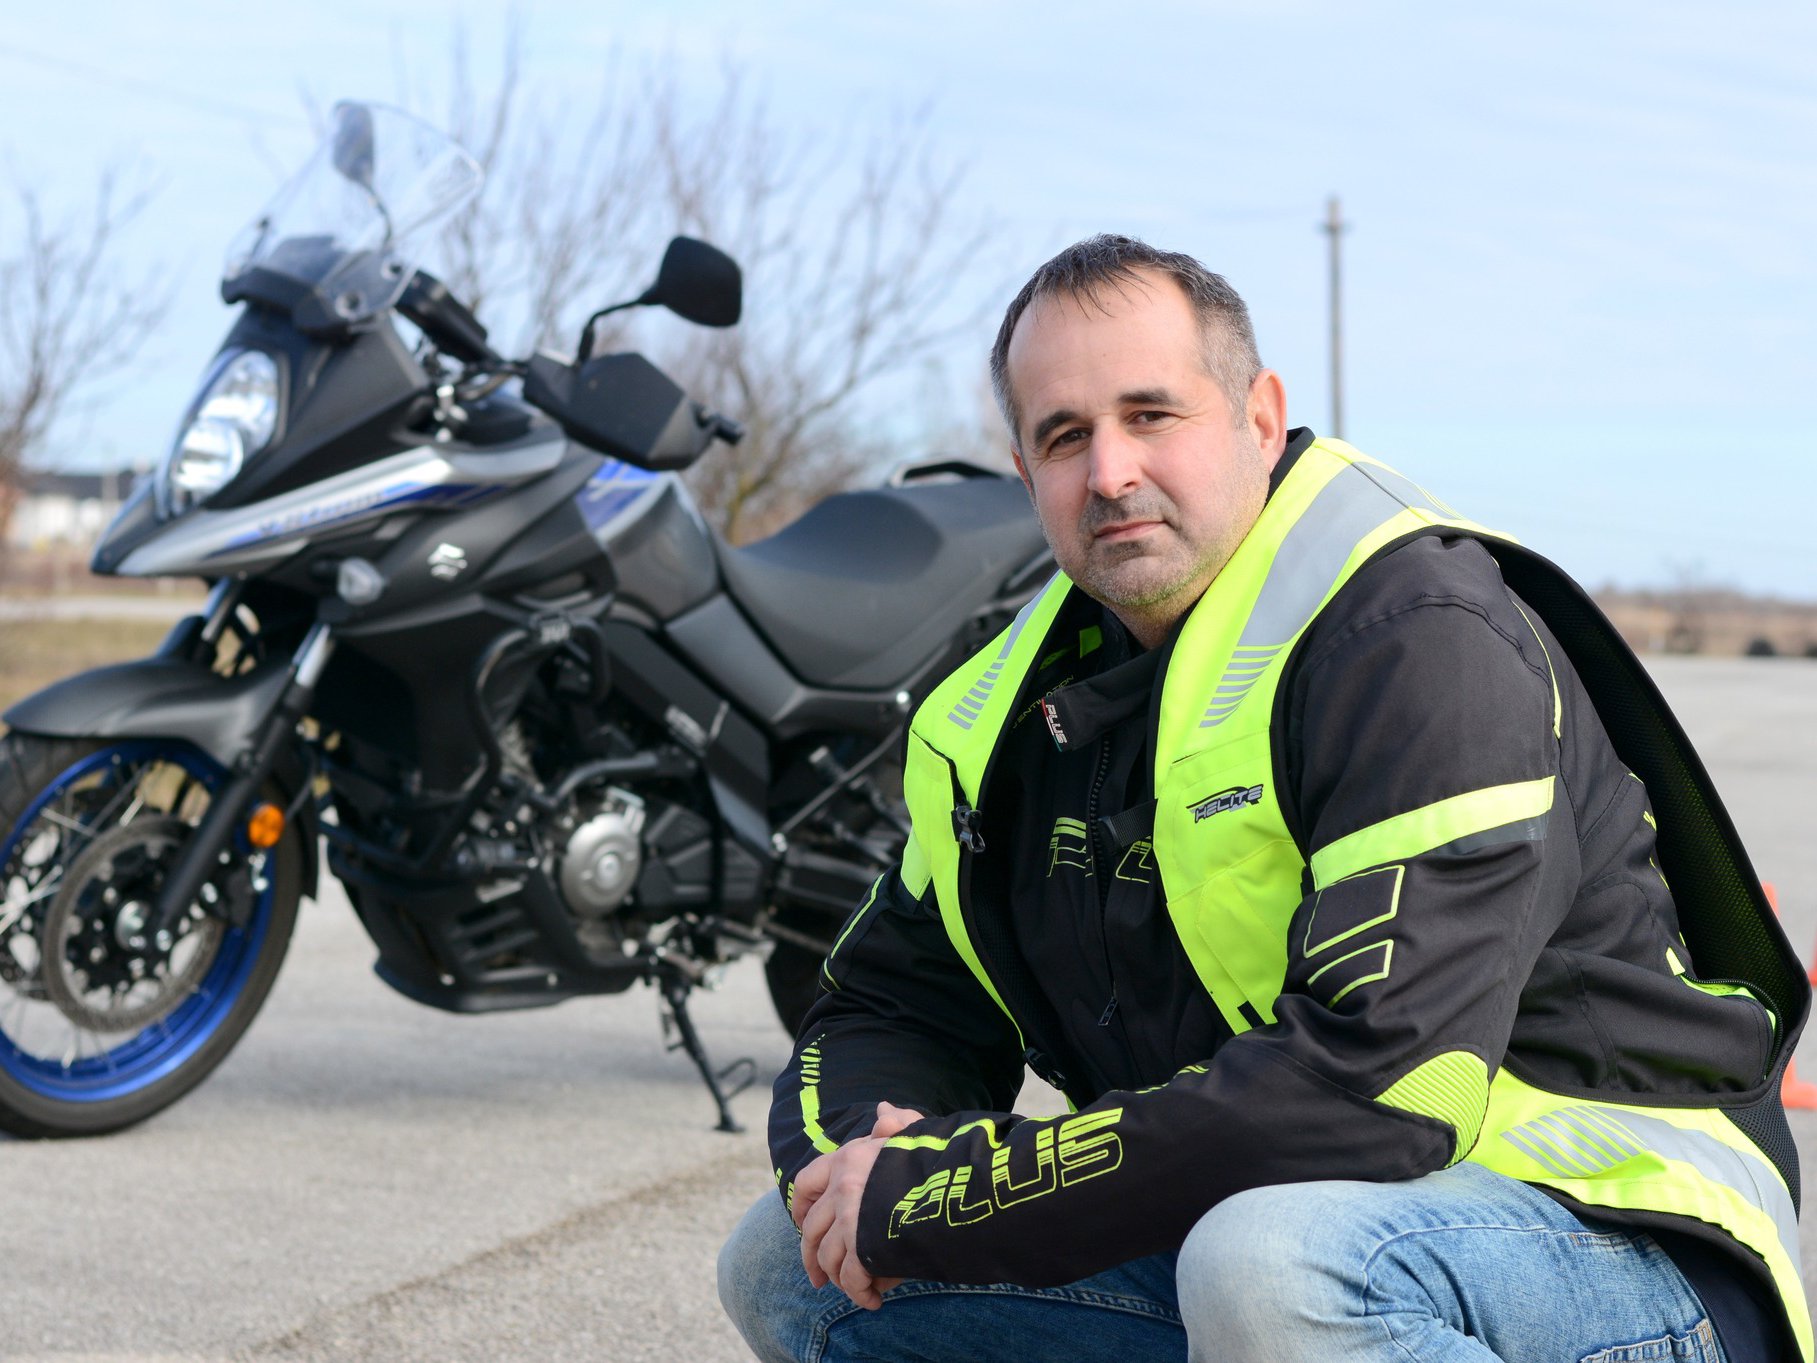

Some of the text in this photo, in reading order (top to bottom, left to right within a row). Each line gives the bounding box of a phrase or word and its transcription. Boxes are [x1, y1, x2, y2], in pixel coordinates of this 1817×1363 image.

[1045, 704, 1068, 744] PLUS
[1194, 784, 1264, 823] HELITE
[888, 1107, 1124, 1239] PLUS
